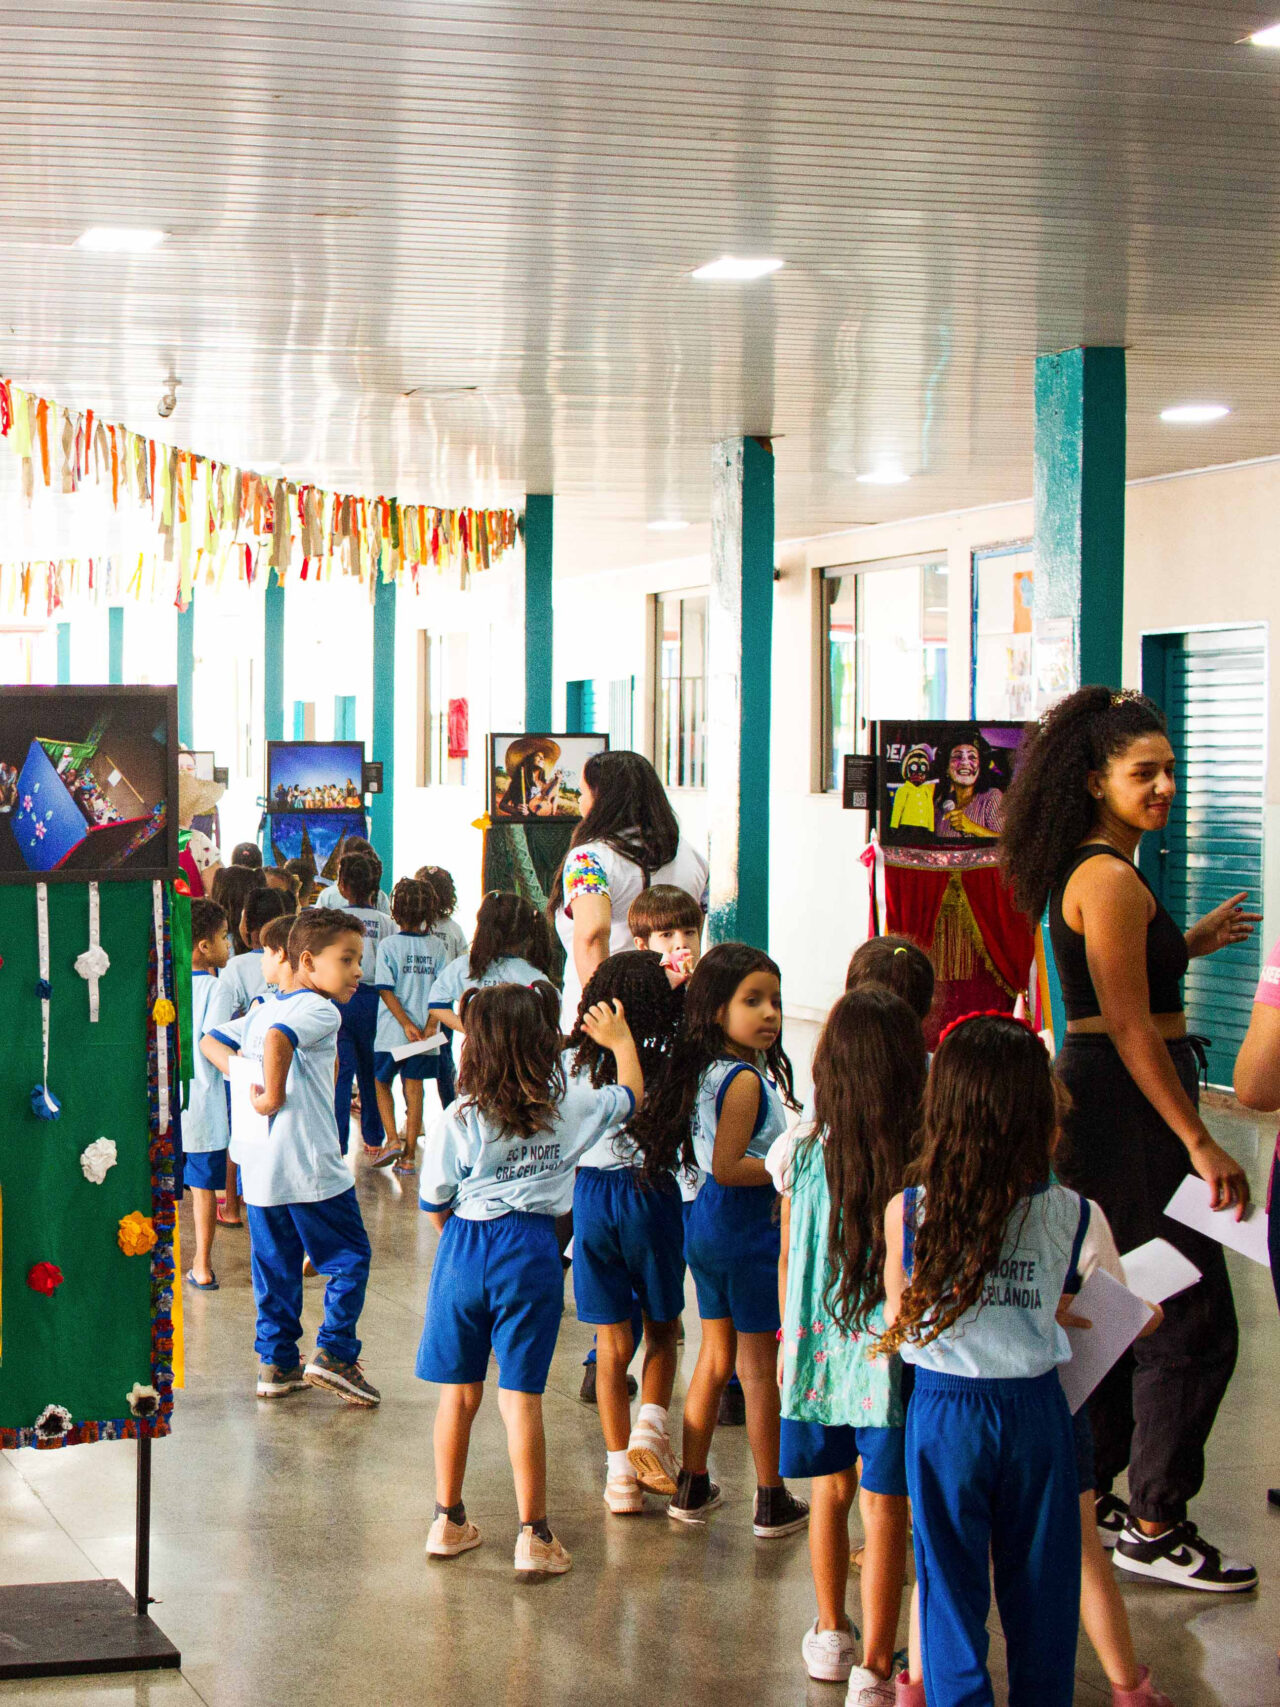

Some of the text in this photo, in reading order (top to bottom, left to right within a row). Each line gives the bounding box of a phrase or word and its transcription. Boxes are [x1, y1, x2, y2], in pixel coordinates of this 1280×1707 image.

[507, 1143, 561, 1162] EC P NORTE
[495, 1165, 516, 1180] CRE
